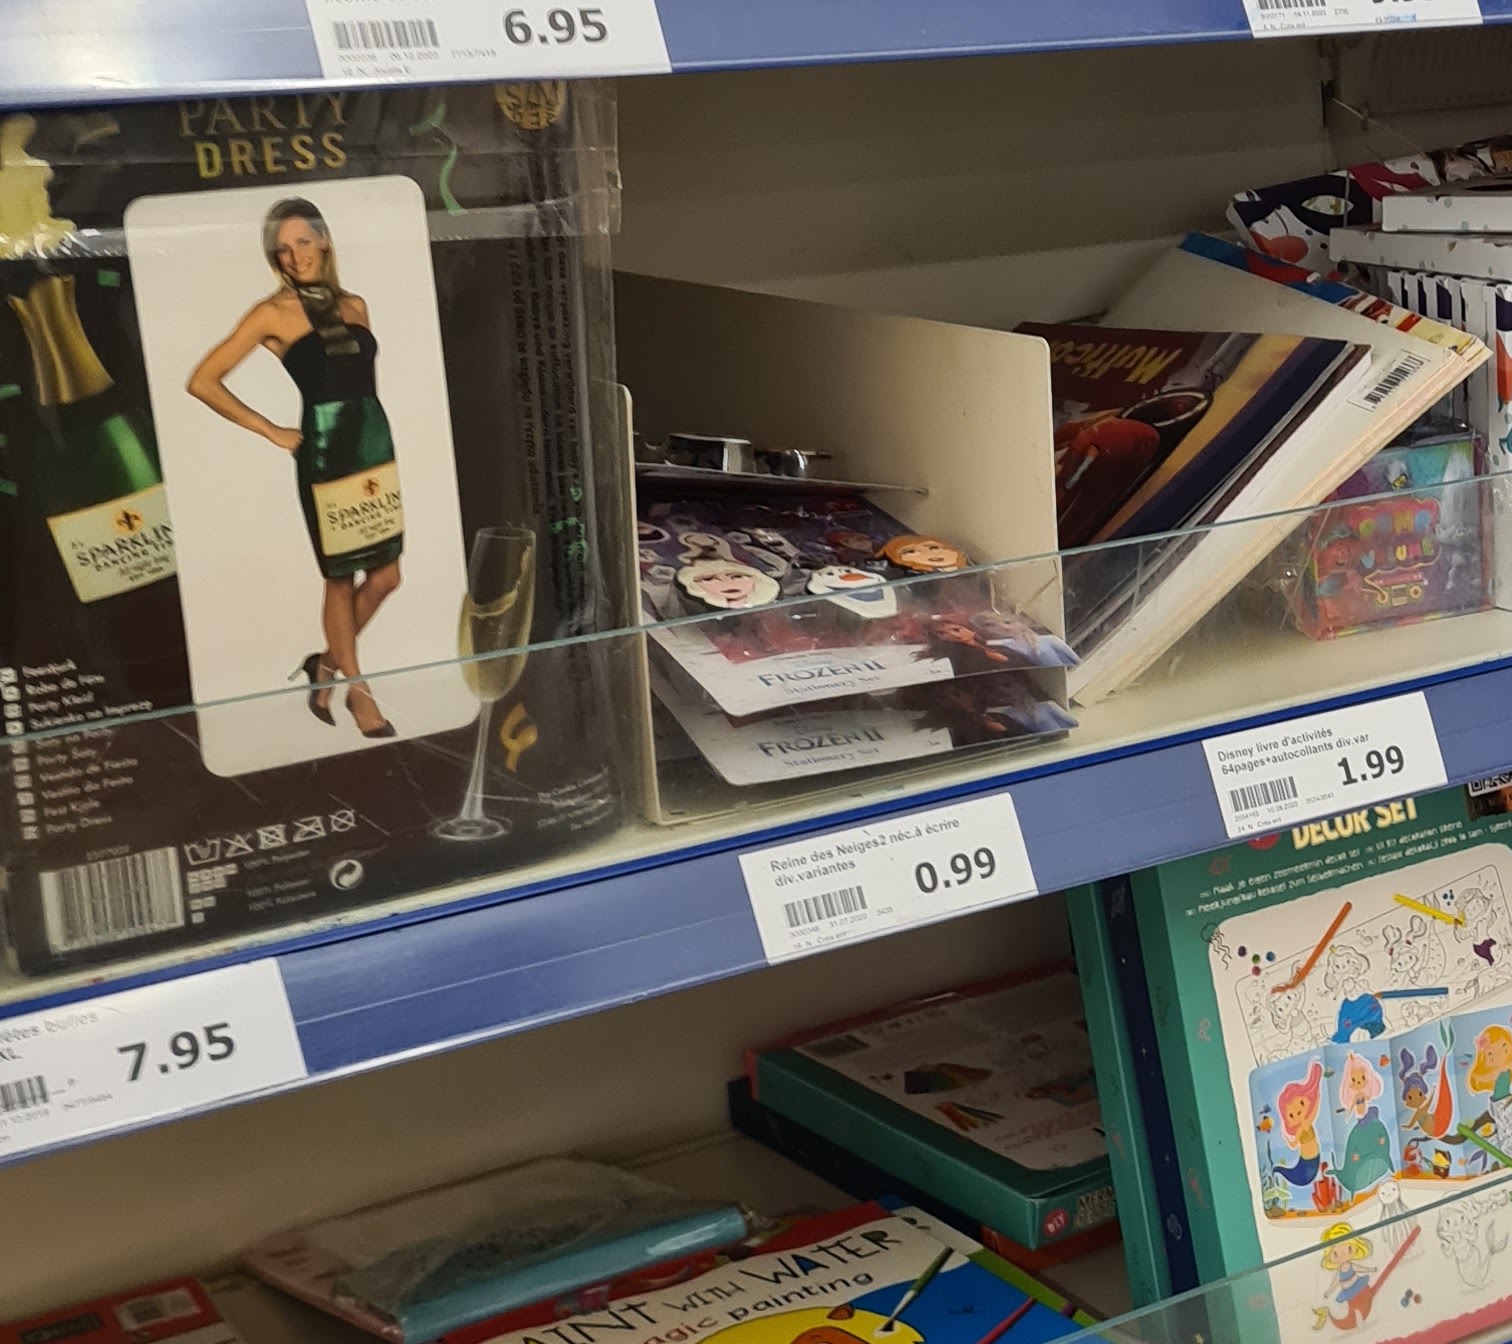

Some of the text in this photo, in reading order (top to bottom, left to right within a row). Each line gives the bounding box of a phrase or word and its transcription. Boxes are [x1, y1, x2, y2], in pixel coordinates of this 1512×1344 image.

[504, 8, 608, 45] 6.95
[195, 132, 347, 178] DRESS
[758, 662, 864, 687] FROZEN
[757, 731, 860, 756] FROZEN
[1218, 728, 1334, 763] Disney livre d'activités
[1222, 733, 1370, 776] 64pages+autocollants div.var
[1337, 744, 1403, 786] 1.99
[770, 854, 808, 873] Reine
[810, 849, 834, 863] des
[836, 834, 888, 857] Neiges2
[775, 860, 857, 887] div.variantes
[915, 847, 995, 894] 0.99
[117, 1022, 235, 1082] 7.95
[745, 1233, 903, 1285] WATER
[727, 1269, 875, 1324] painting
